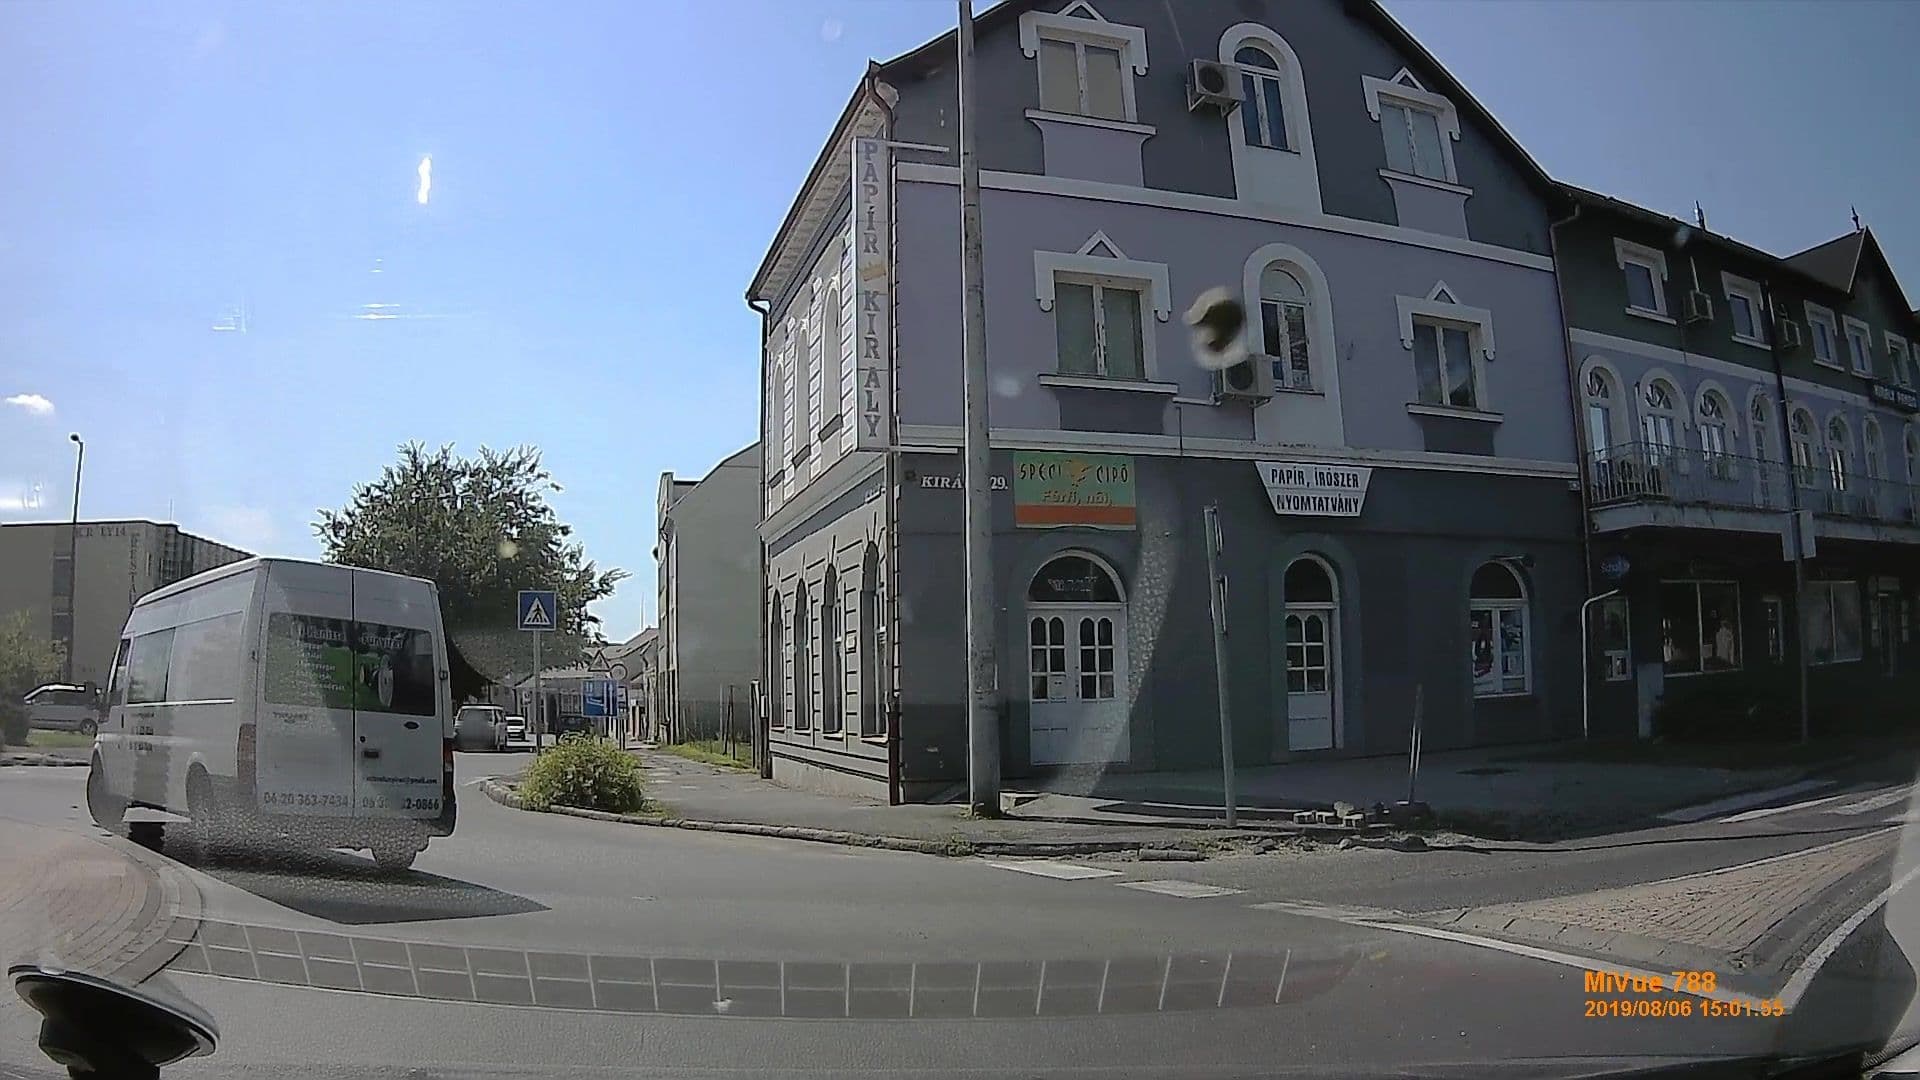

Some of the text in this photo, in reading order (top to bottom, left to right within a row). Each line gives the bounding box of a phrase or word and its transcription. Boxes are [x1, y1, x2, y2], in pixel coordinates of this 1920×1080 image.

[921, 473, 1009, 490] KIRÁ 29.
[1020, 463, 1062, 481] SPECI
[1270, 466, 1311, 488] PAPÍR,
[1276, 493, 1359, 513] NYOMTATVÁNY
